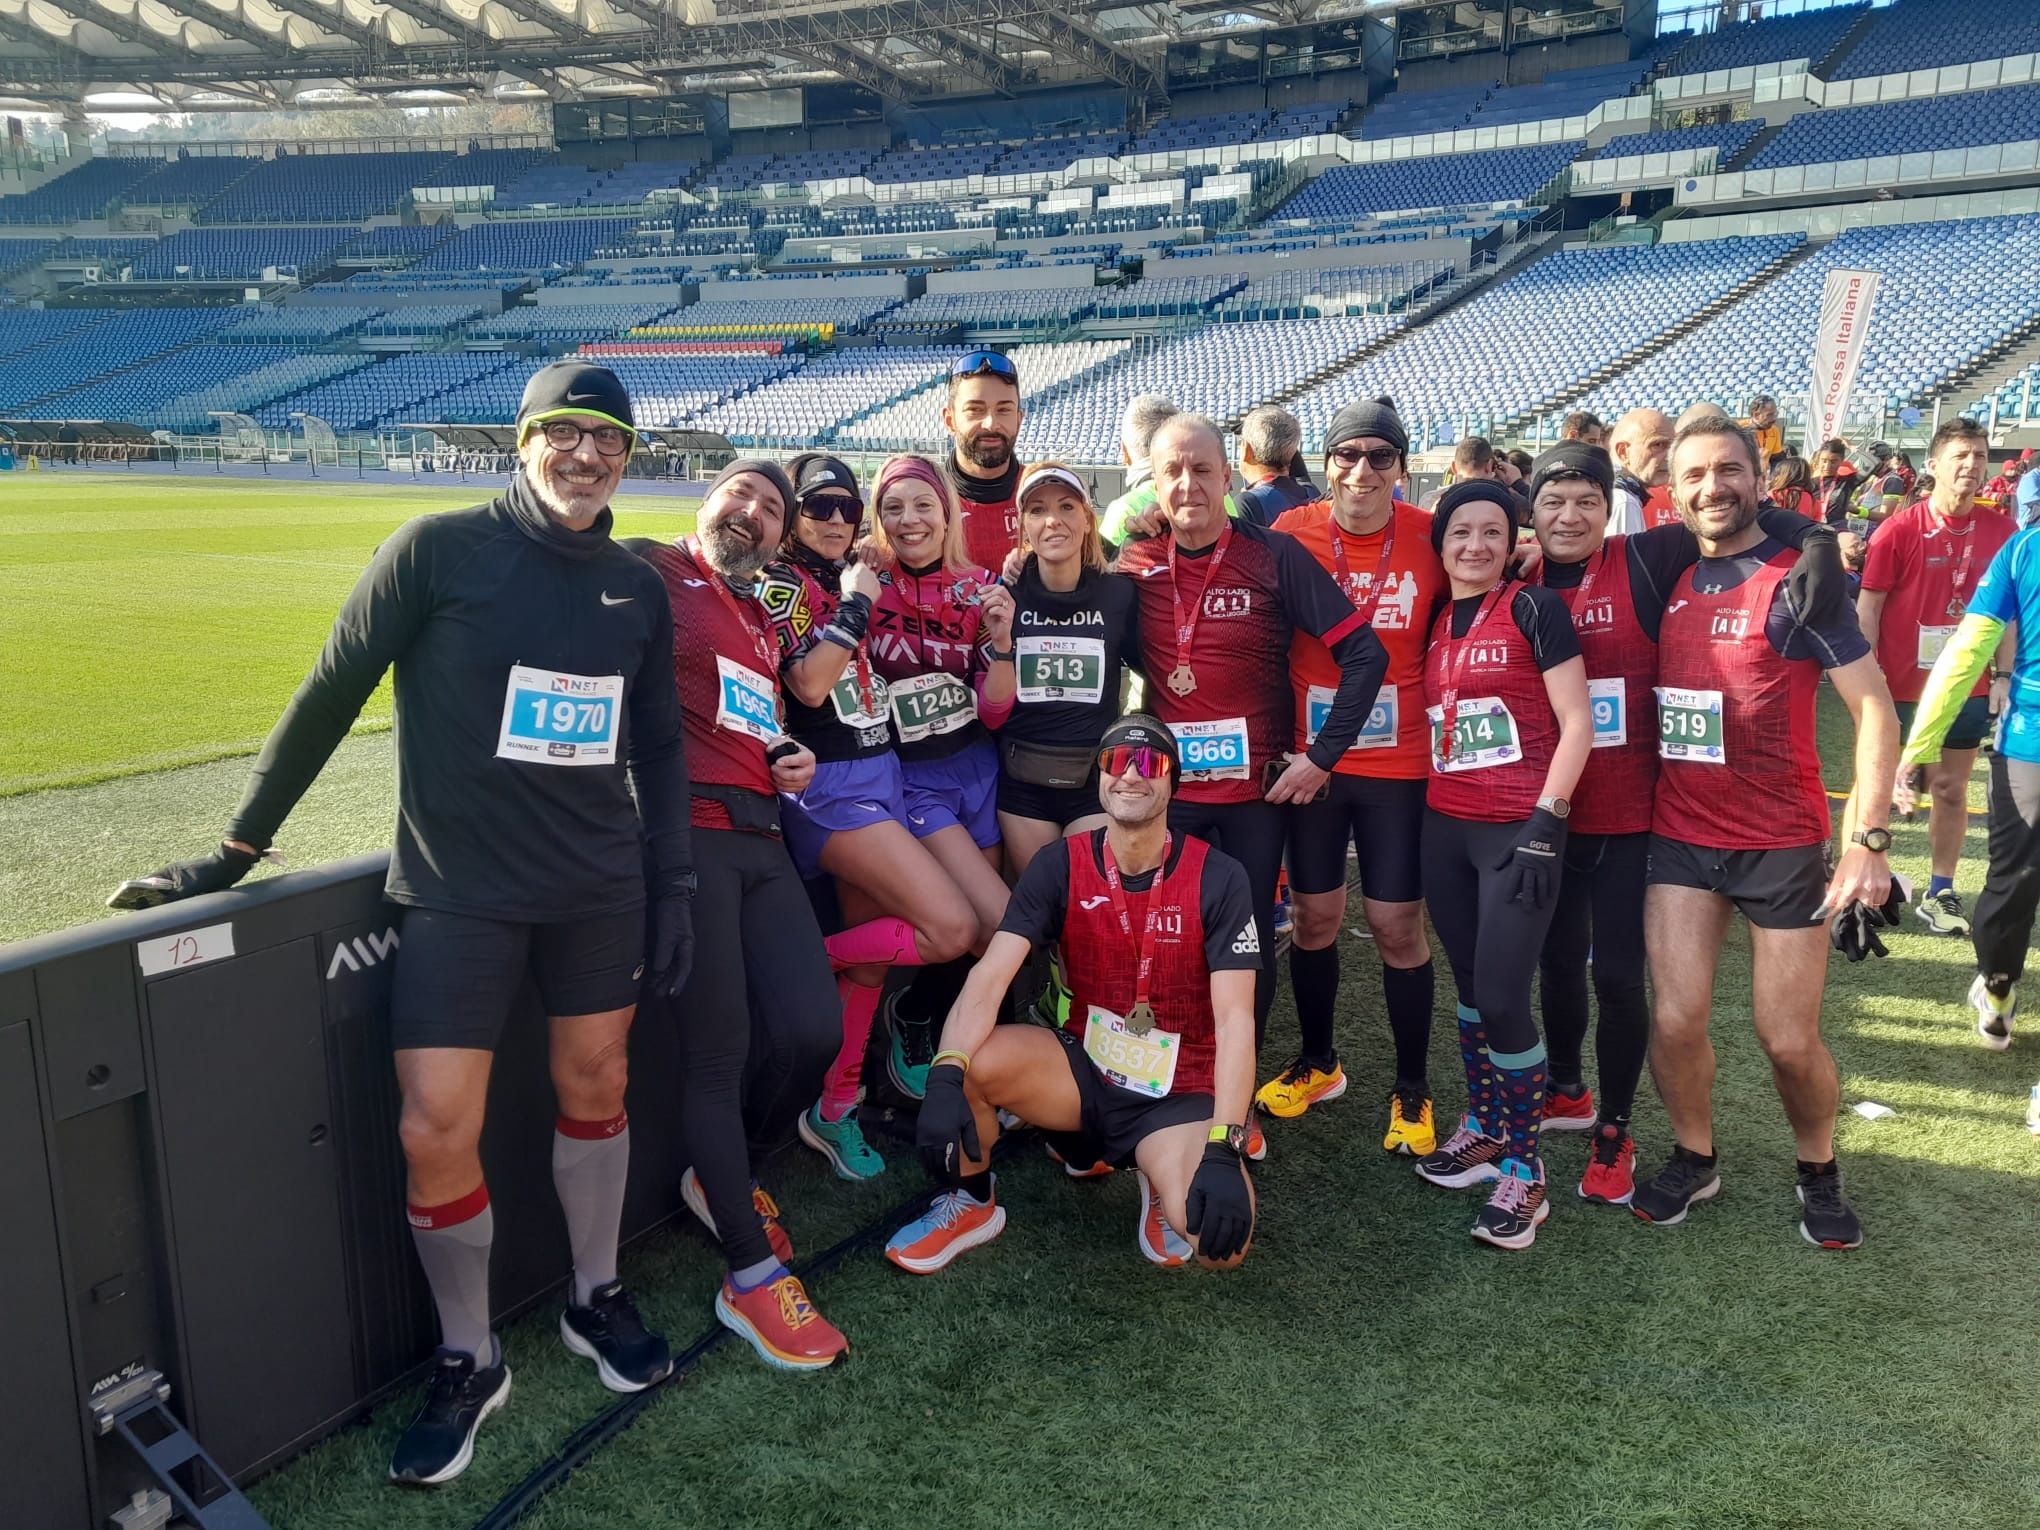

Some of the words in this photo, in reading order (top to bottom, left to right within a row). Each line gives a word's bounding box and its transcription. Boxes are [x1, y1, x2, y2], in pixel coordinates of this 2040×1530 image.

[1835, 277, 1861, 344] Italiana
[1825, 350, 1847, 406] Rossa
[1206, 588, 1225, 596] ALTO
[1227, 588, 1250, 596] LAZIO
[1595, 596, 1612, 604] LAZIO
[876, 607, 964, 640] ZERO
[1716, 607, 1730, 615] ALTO
[1731, 607, 1750, 616] LAZIO
[868, 632, 974, 669] WATT
[1053, 642, 1078, 650] NET
[745, 674, 760, 688] NET
[1036, 657, 1084, 681] 513
[571, 680, 599, 692] NET
[1677, 694, 1697, 704] NET
[531, 698, 606, 733] 1970
[731, 685, 772, 724] 1965
[908, 687, 967, 718] 1248
[1195, 724, 1217, 732] NET
[1662, 710, 1707, 738] 519
[1529, 840, 1551, 851] GORE
[168, 936, 203, 966] 12
[1097, 1031, 1165, 1073] 3537
